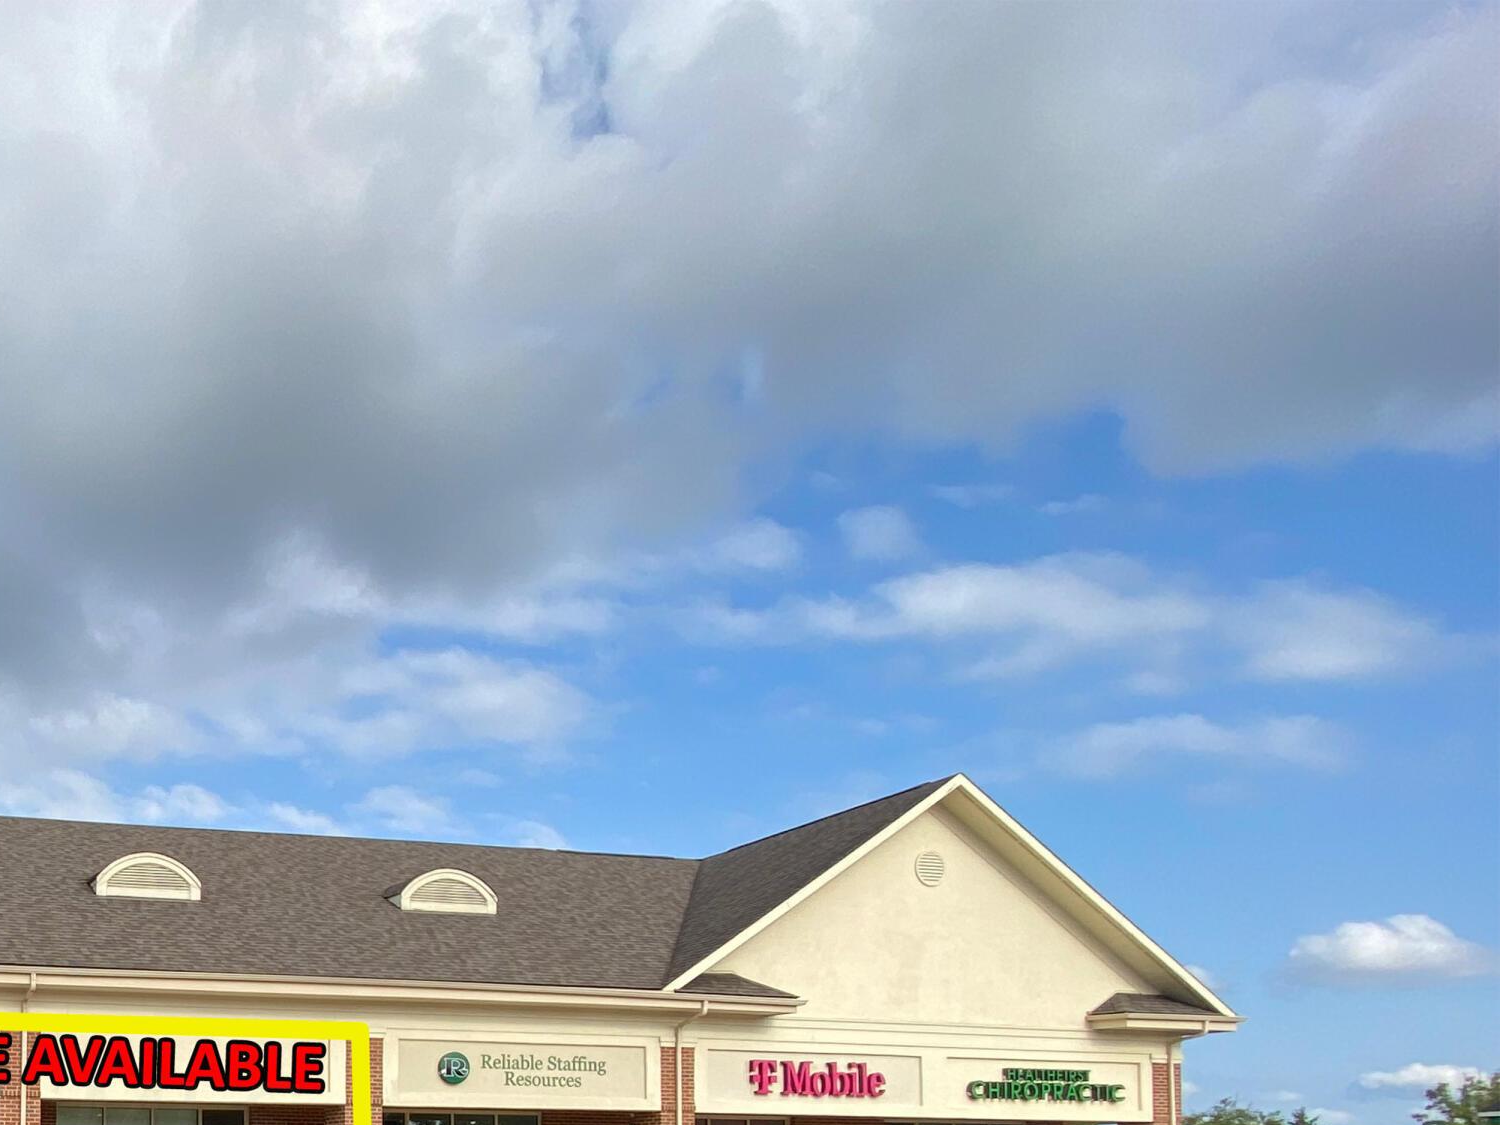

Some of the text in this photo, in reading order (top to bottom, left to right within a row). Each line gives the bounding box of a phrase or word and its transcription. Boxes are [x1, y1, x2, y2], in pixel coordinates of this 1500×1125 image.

[481, 1054, 606, 1075] Reliable Staffing
[504, 1071, 581, 1087] Resources
[966, 1080, 1126, 1102] CHIROPRACTIC
